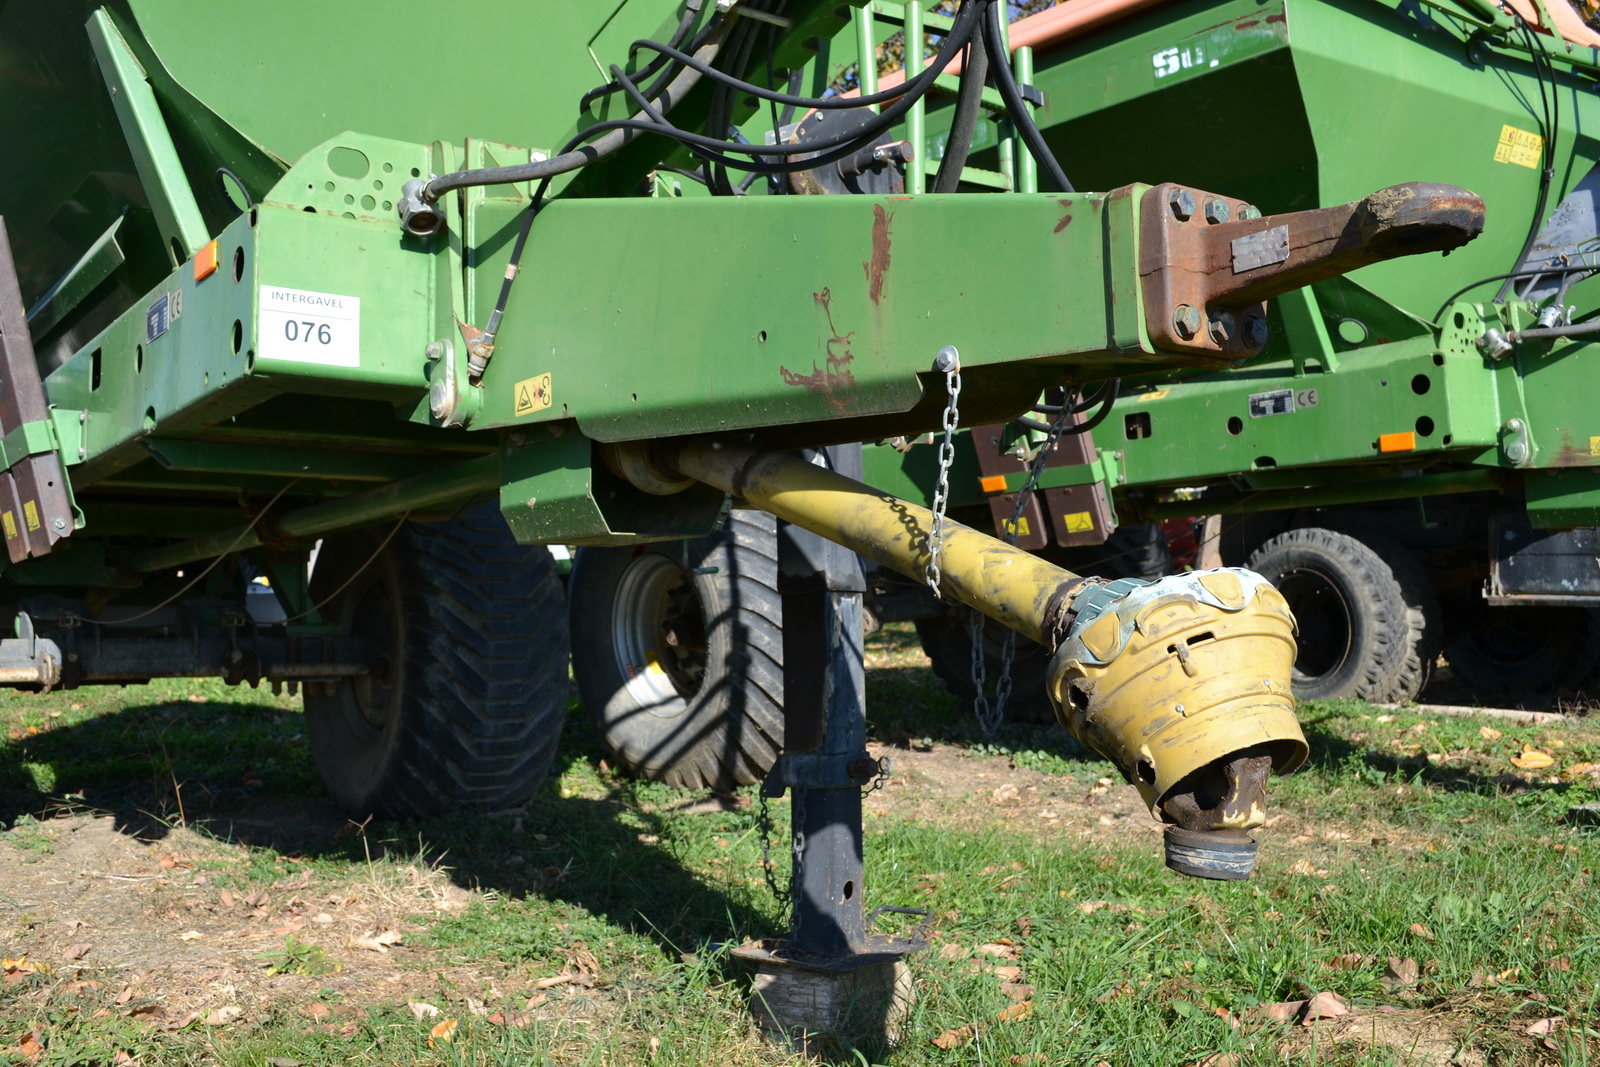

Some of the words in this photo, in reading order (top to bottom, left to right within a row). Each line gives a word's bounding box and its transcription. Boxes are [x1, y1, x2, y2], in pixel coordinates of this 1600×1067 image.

[271, 291, 344, 309] INTERGAVEL
[284, 319, 332, 345] 076
[1297, 389, 1317, 407] CE
